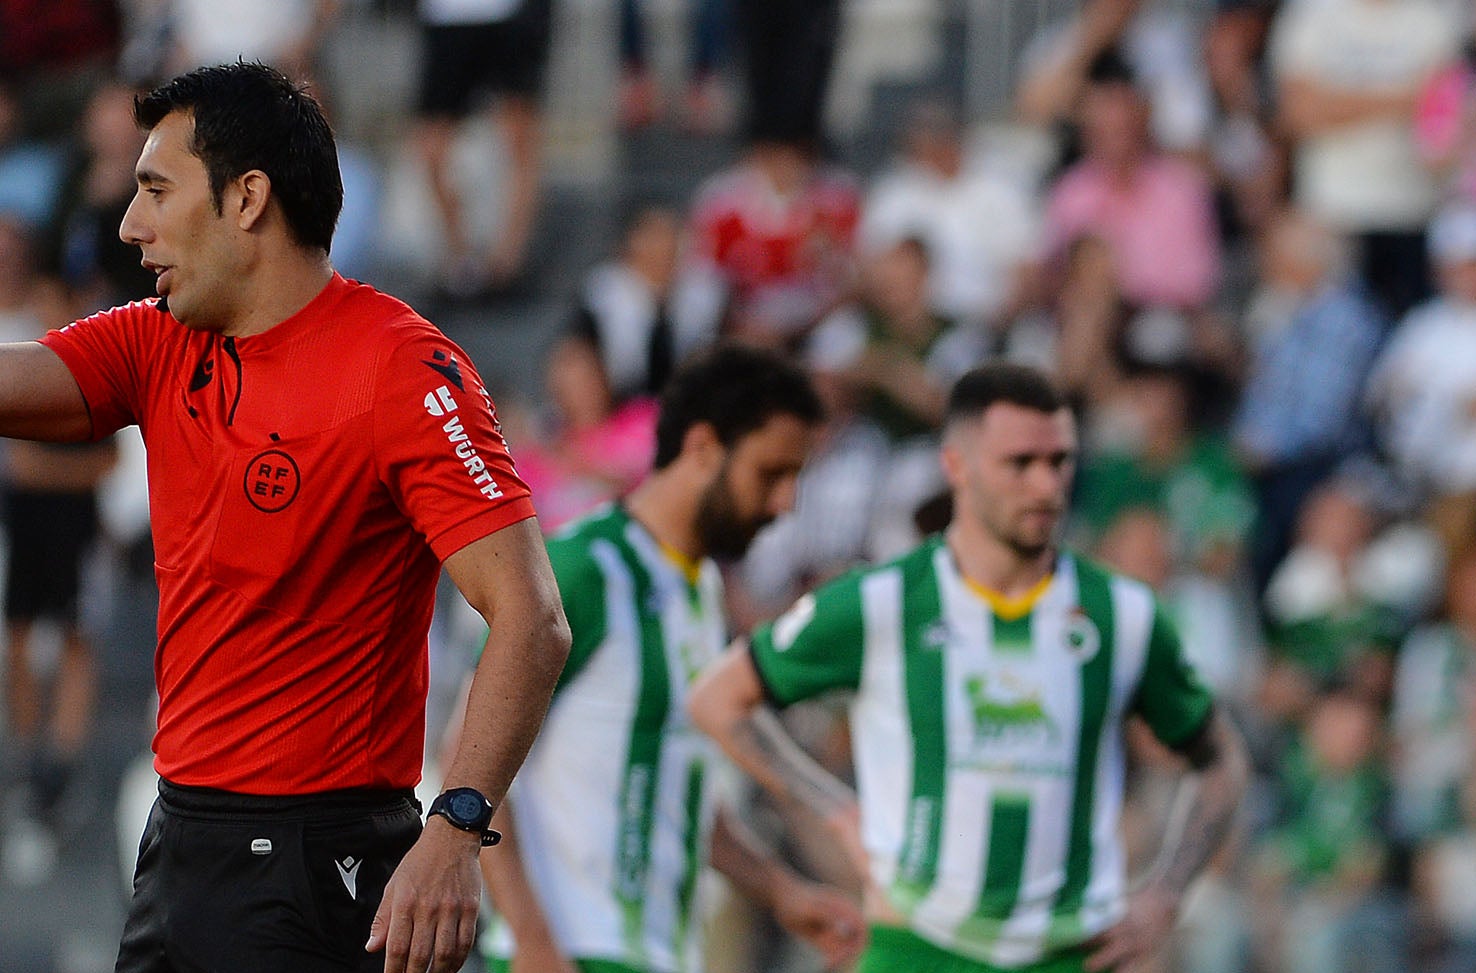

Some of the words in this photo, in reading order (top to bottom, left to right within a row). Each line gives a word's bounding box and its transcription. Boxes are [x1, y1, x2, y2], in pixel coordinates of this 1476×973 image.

[442, 415, 504, 500] WÜRTH
[258, 462, 289, 481] RF
[254, 481, 286, 499] EF
